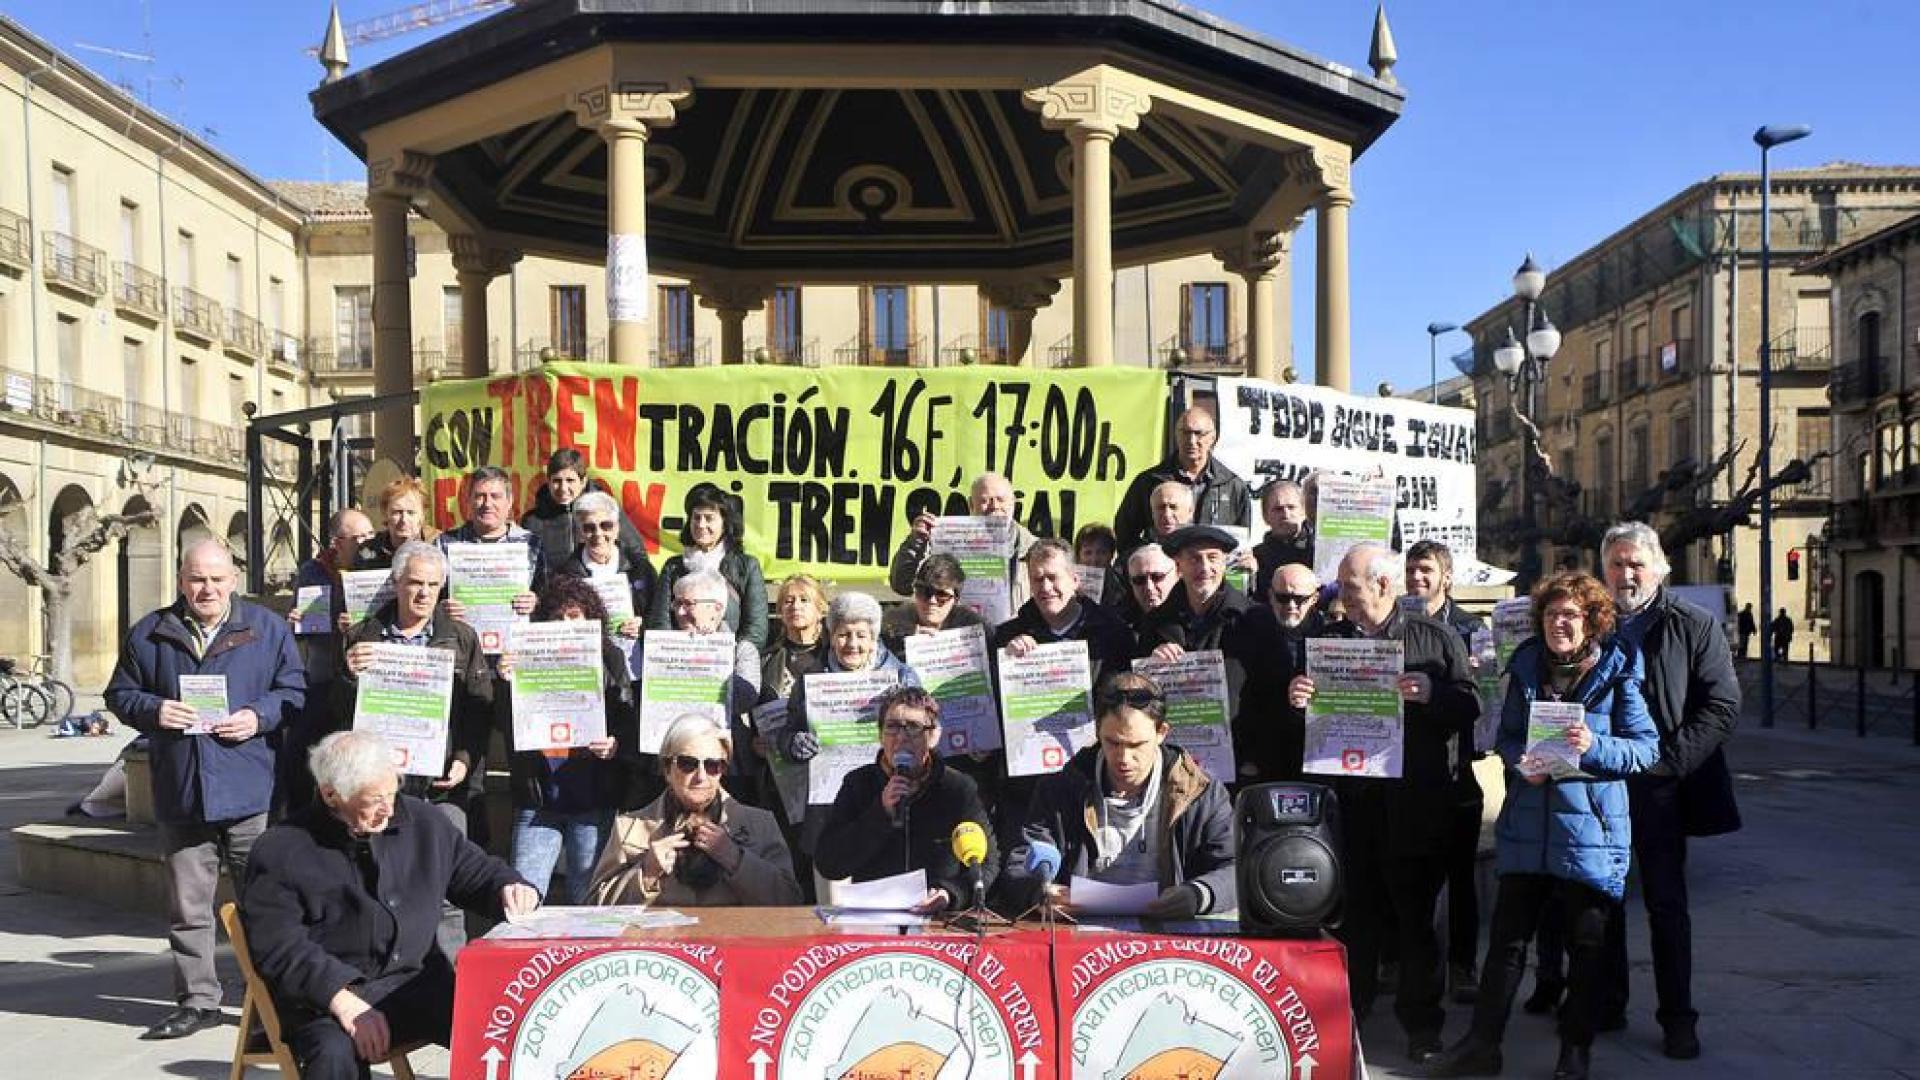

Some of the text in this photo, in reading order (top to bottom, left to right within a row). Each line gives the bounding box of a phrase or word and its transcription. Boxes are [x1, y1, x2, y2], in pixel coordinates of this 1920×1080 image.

[973, 381, 1126, 481] 17:00h
[1237, 386, 1325, 444] TODO
[1331, 405, 1398, 454] SIGUE
[768, 481, 895, 566] TREN
[635, 959, 680, 986] POR
[899, 961, 943, 989] POR
[1173, 967, 1218, 993] POR
[484, 1005, 515, 1043] NO
[748, 1007, 783, 1047] NO
[977, 953, 1043, 1050] EL TREN
[1252, 958, 1282, 995] EL
[1276, 986, 1320, 1053] TREN
